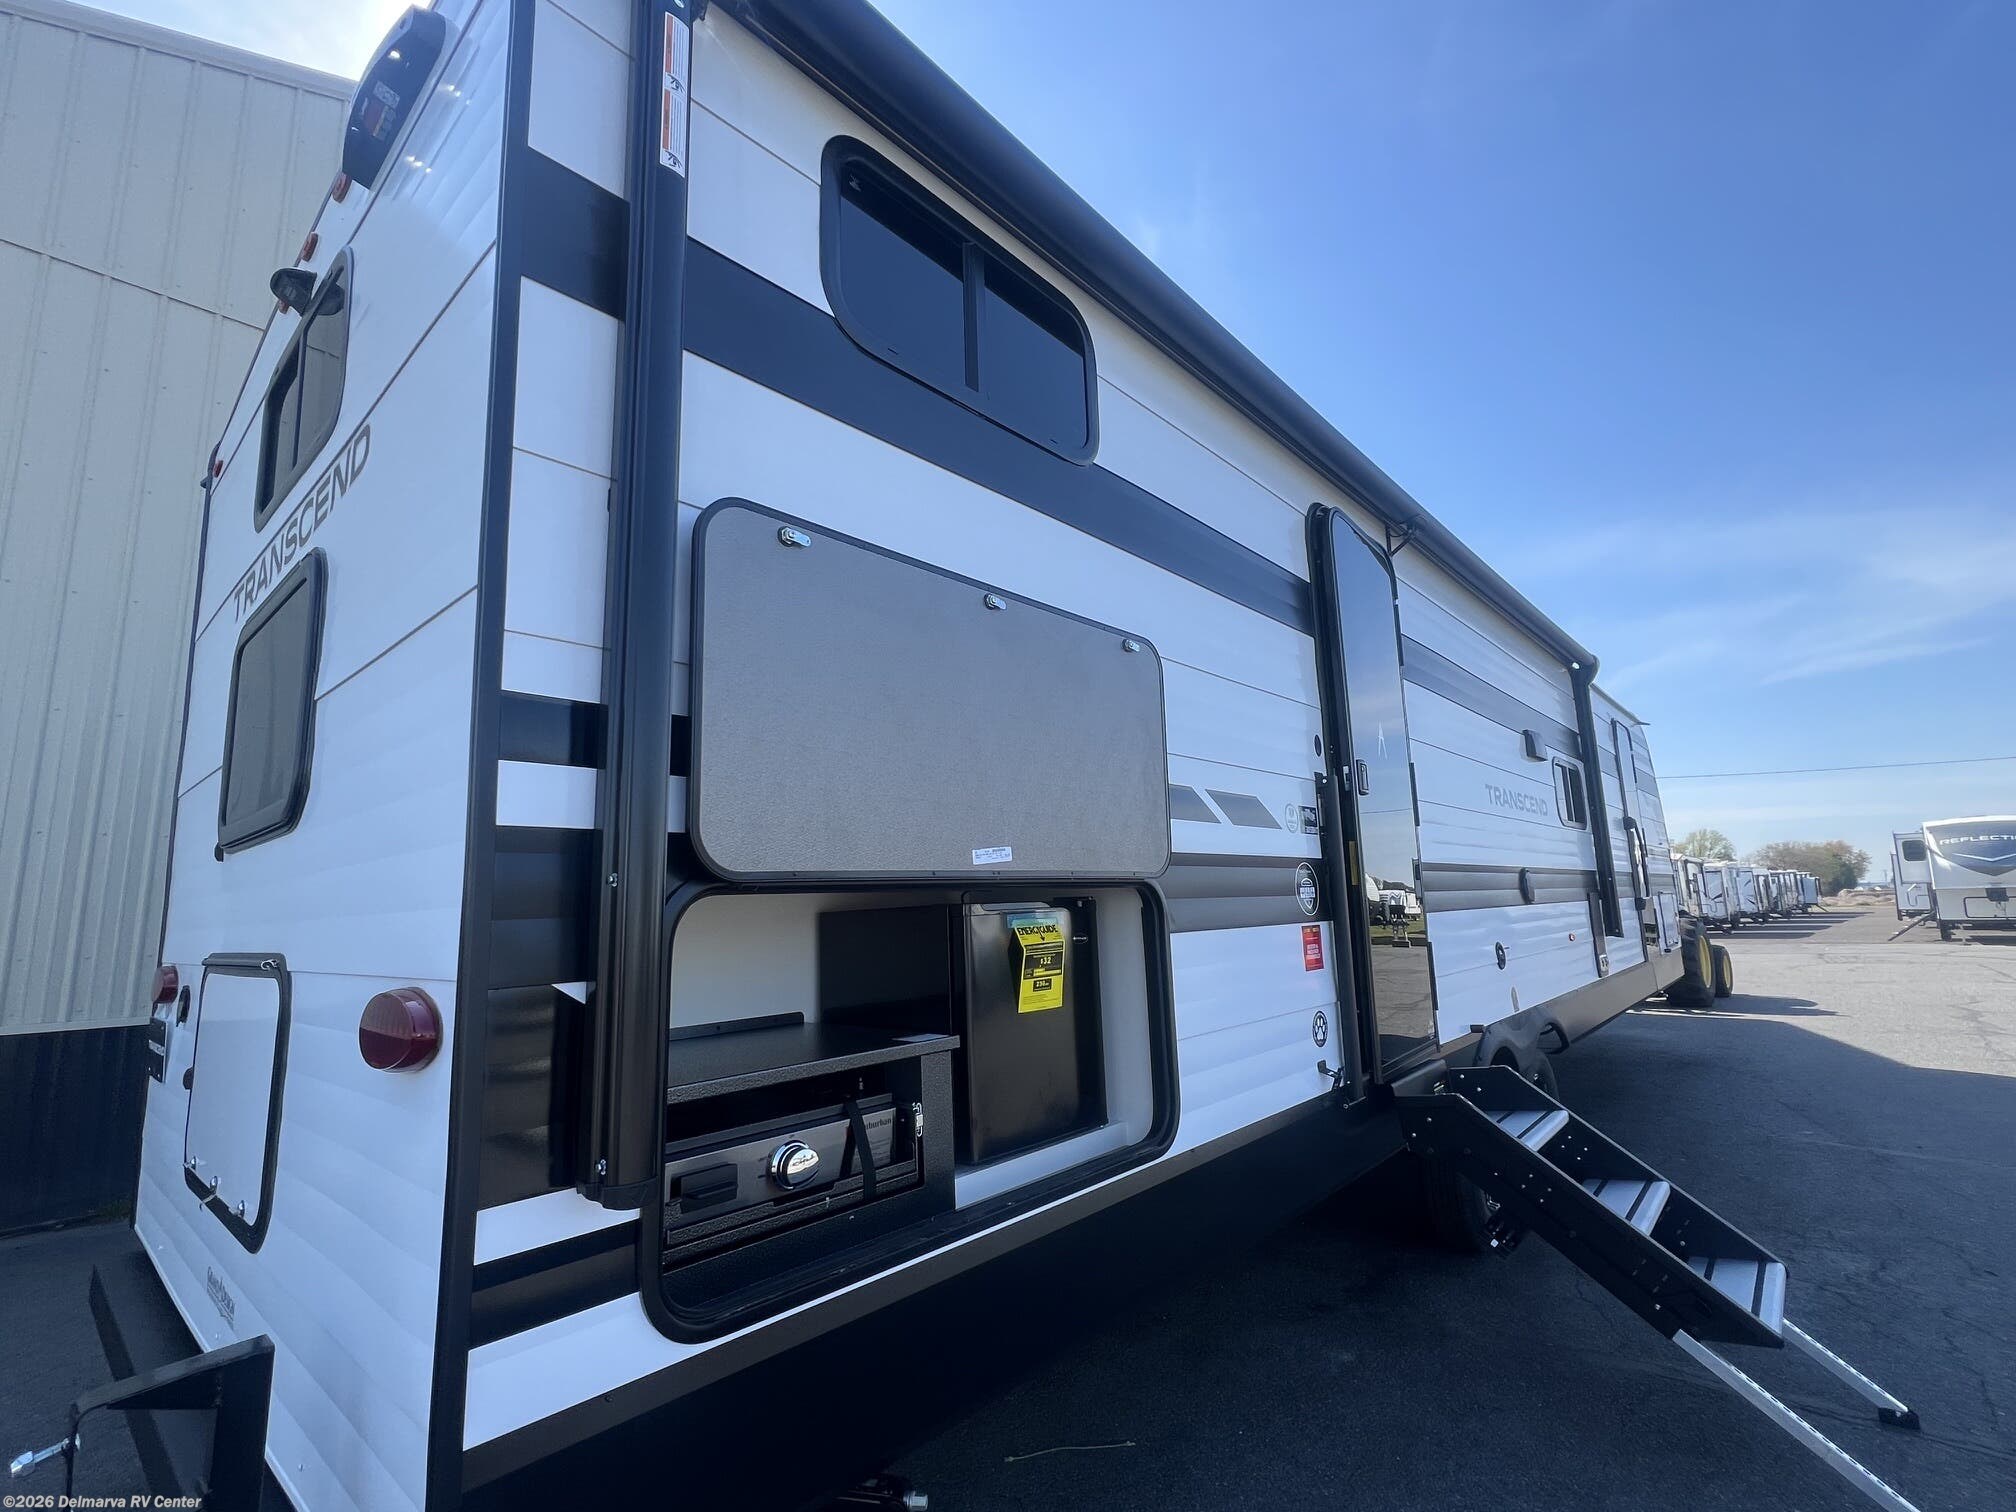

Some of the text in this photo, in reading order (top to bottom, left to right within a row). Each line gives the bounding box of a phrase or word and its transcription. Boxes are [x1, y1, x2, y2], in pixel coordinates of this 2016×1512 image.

[233, 424, 371, 624] TRANSCEND
[1485, 784, 1548, 817] TRANSCEND
[1939, 834, 2016, 846] REFLECTI
